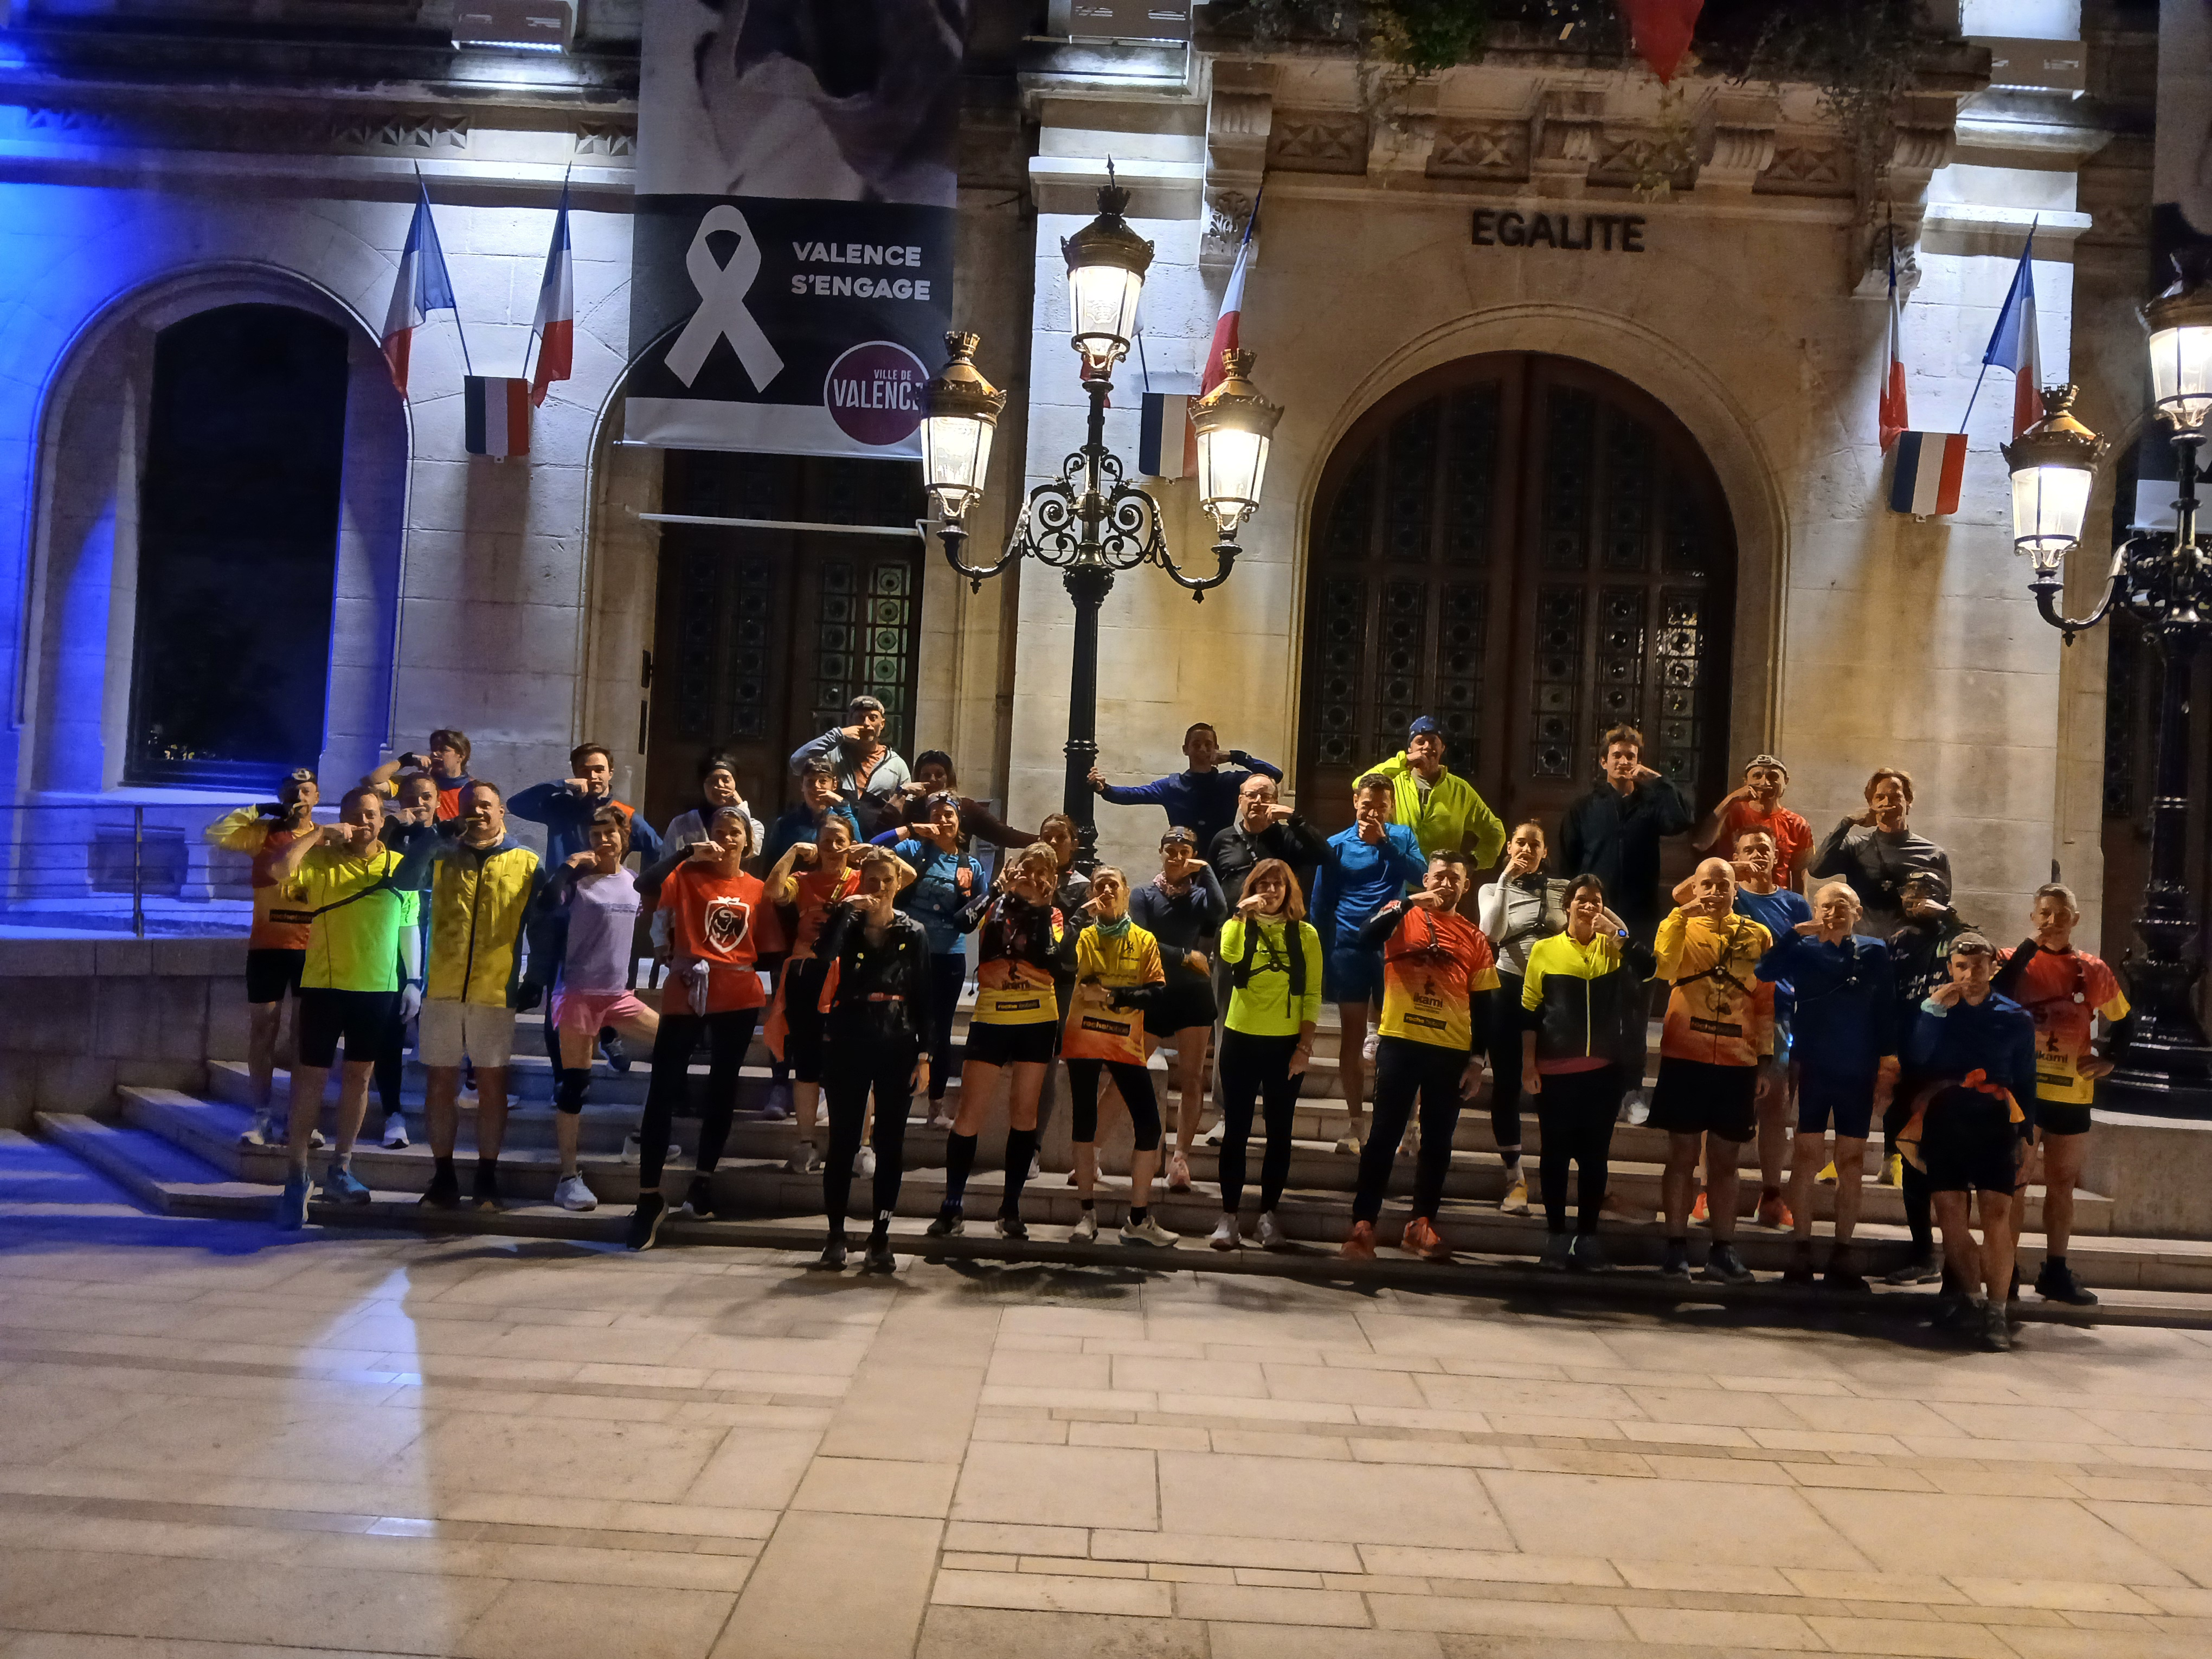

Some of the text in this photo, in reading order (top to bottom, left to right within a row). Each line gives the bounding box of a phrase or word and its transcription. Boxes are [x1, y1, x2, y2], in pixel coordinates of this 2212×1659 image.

[1471, 208, 1646, 253] EGALITE
[792, 242, 921, 267] VALENCE
[791, 274, 930, 300] S'ENGAGE
[874, 369, 911, 380] VILLE DE
